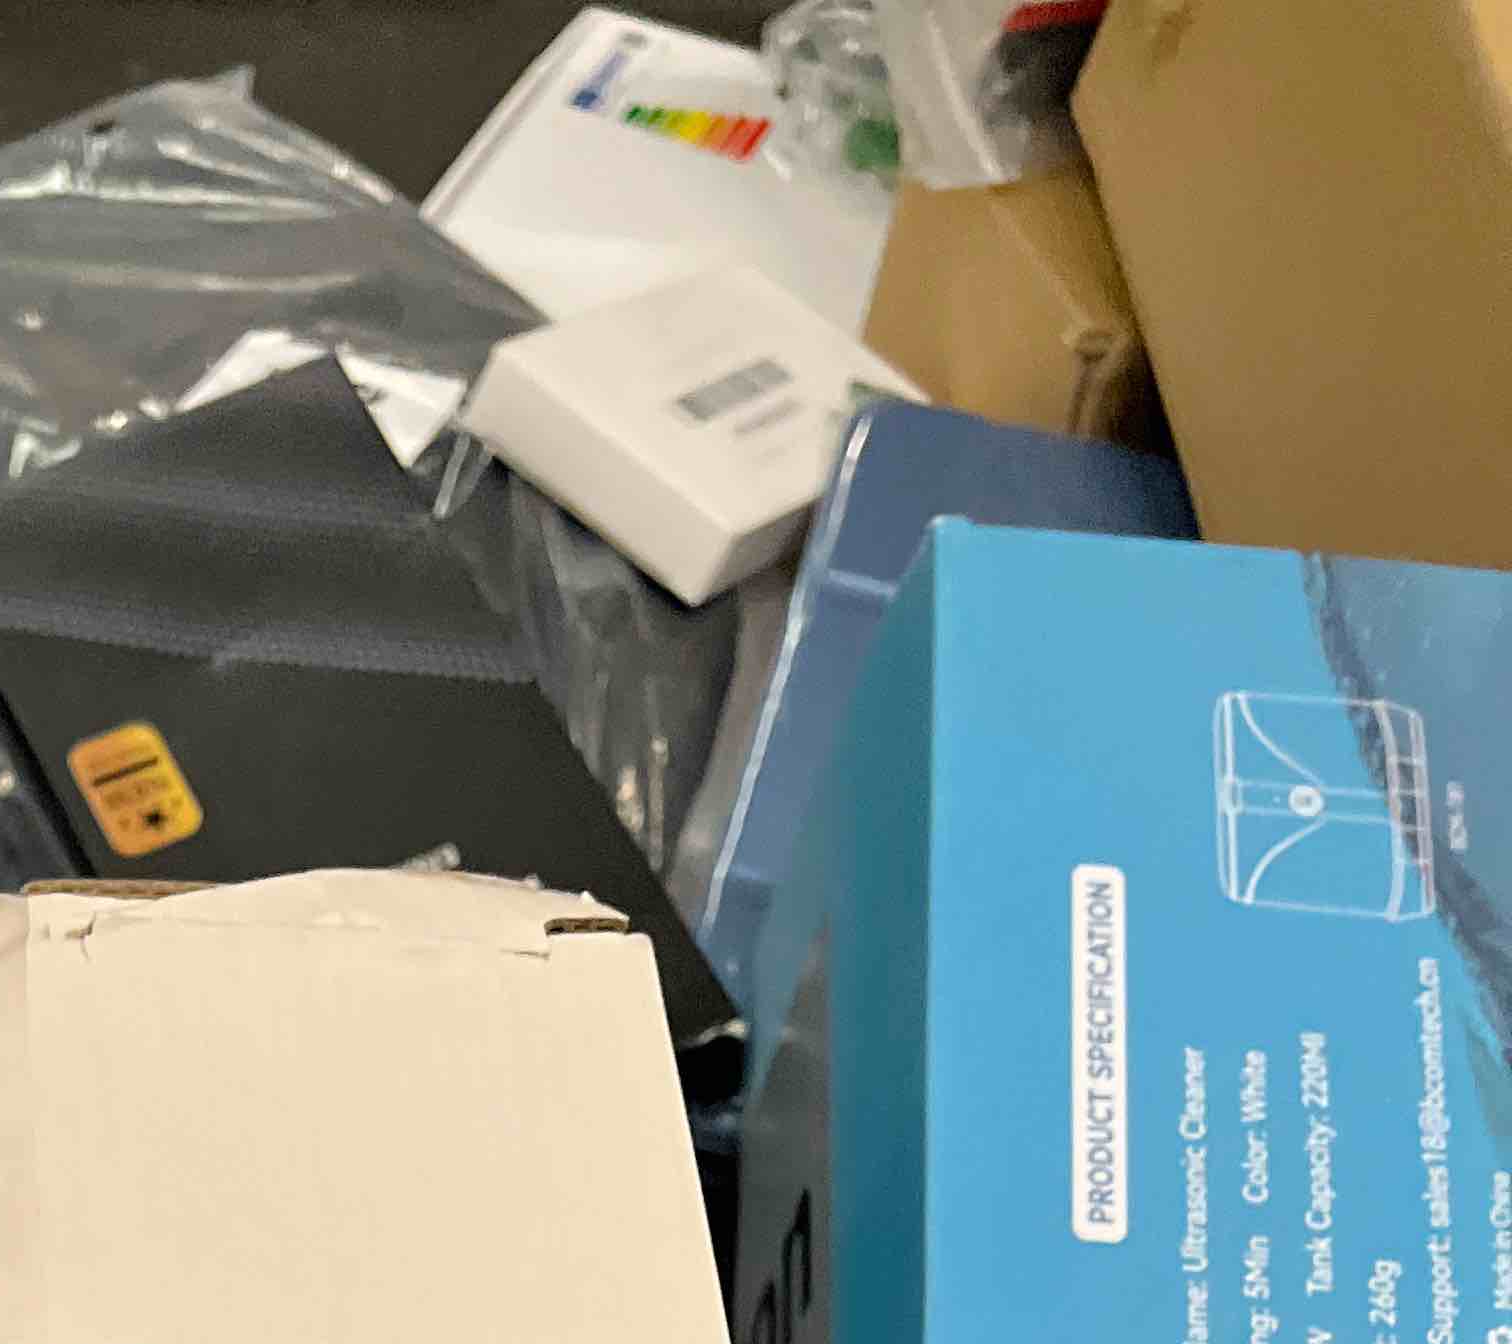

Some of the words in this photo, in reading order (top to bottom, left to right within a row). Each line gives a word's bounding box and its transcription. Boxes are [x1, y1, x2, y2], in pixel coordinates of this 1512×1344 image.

[1087, 881, 1115, 1080] SPECIFICATION
[1178, 1046, 1207, 1140] Cleaner
[1240, 1049, 1268, 1123] White
[1088, 1091, 1115, 1225] PRODUCT
[1241, 1129, 1270, 1204] Color:
[1304, 1112, 1338, 1231] Capacity:
[1178, 1145, 1209, 1272] Ultrasonic
[1243, 1235, 1271, 1300] 5Min
[1304, 1236, 1335, 1297] Tank
[1368, 1258, 1403, 1328] 260g
